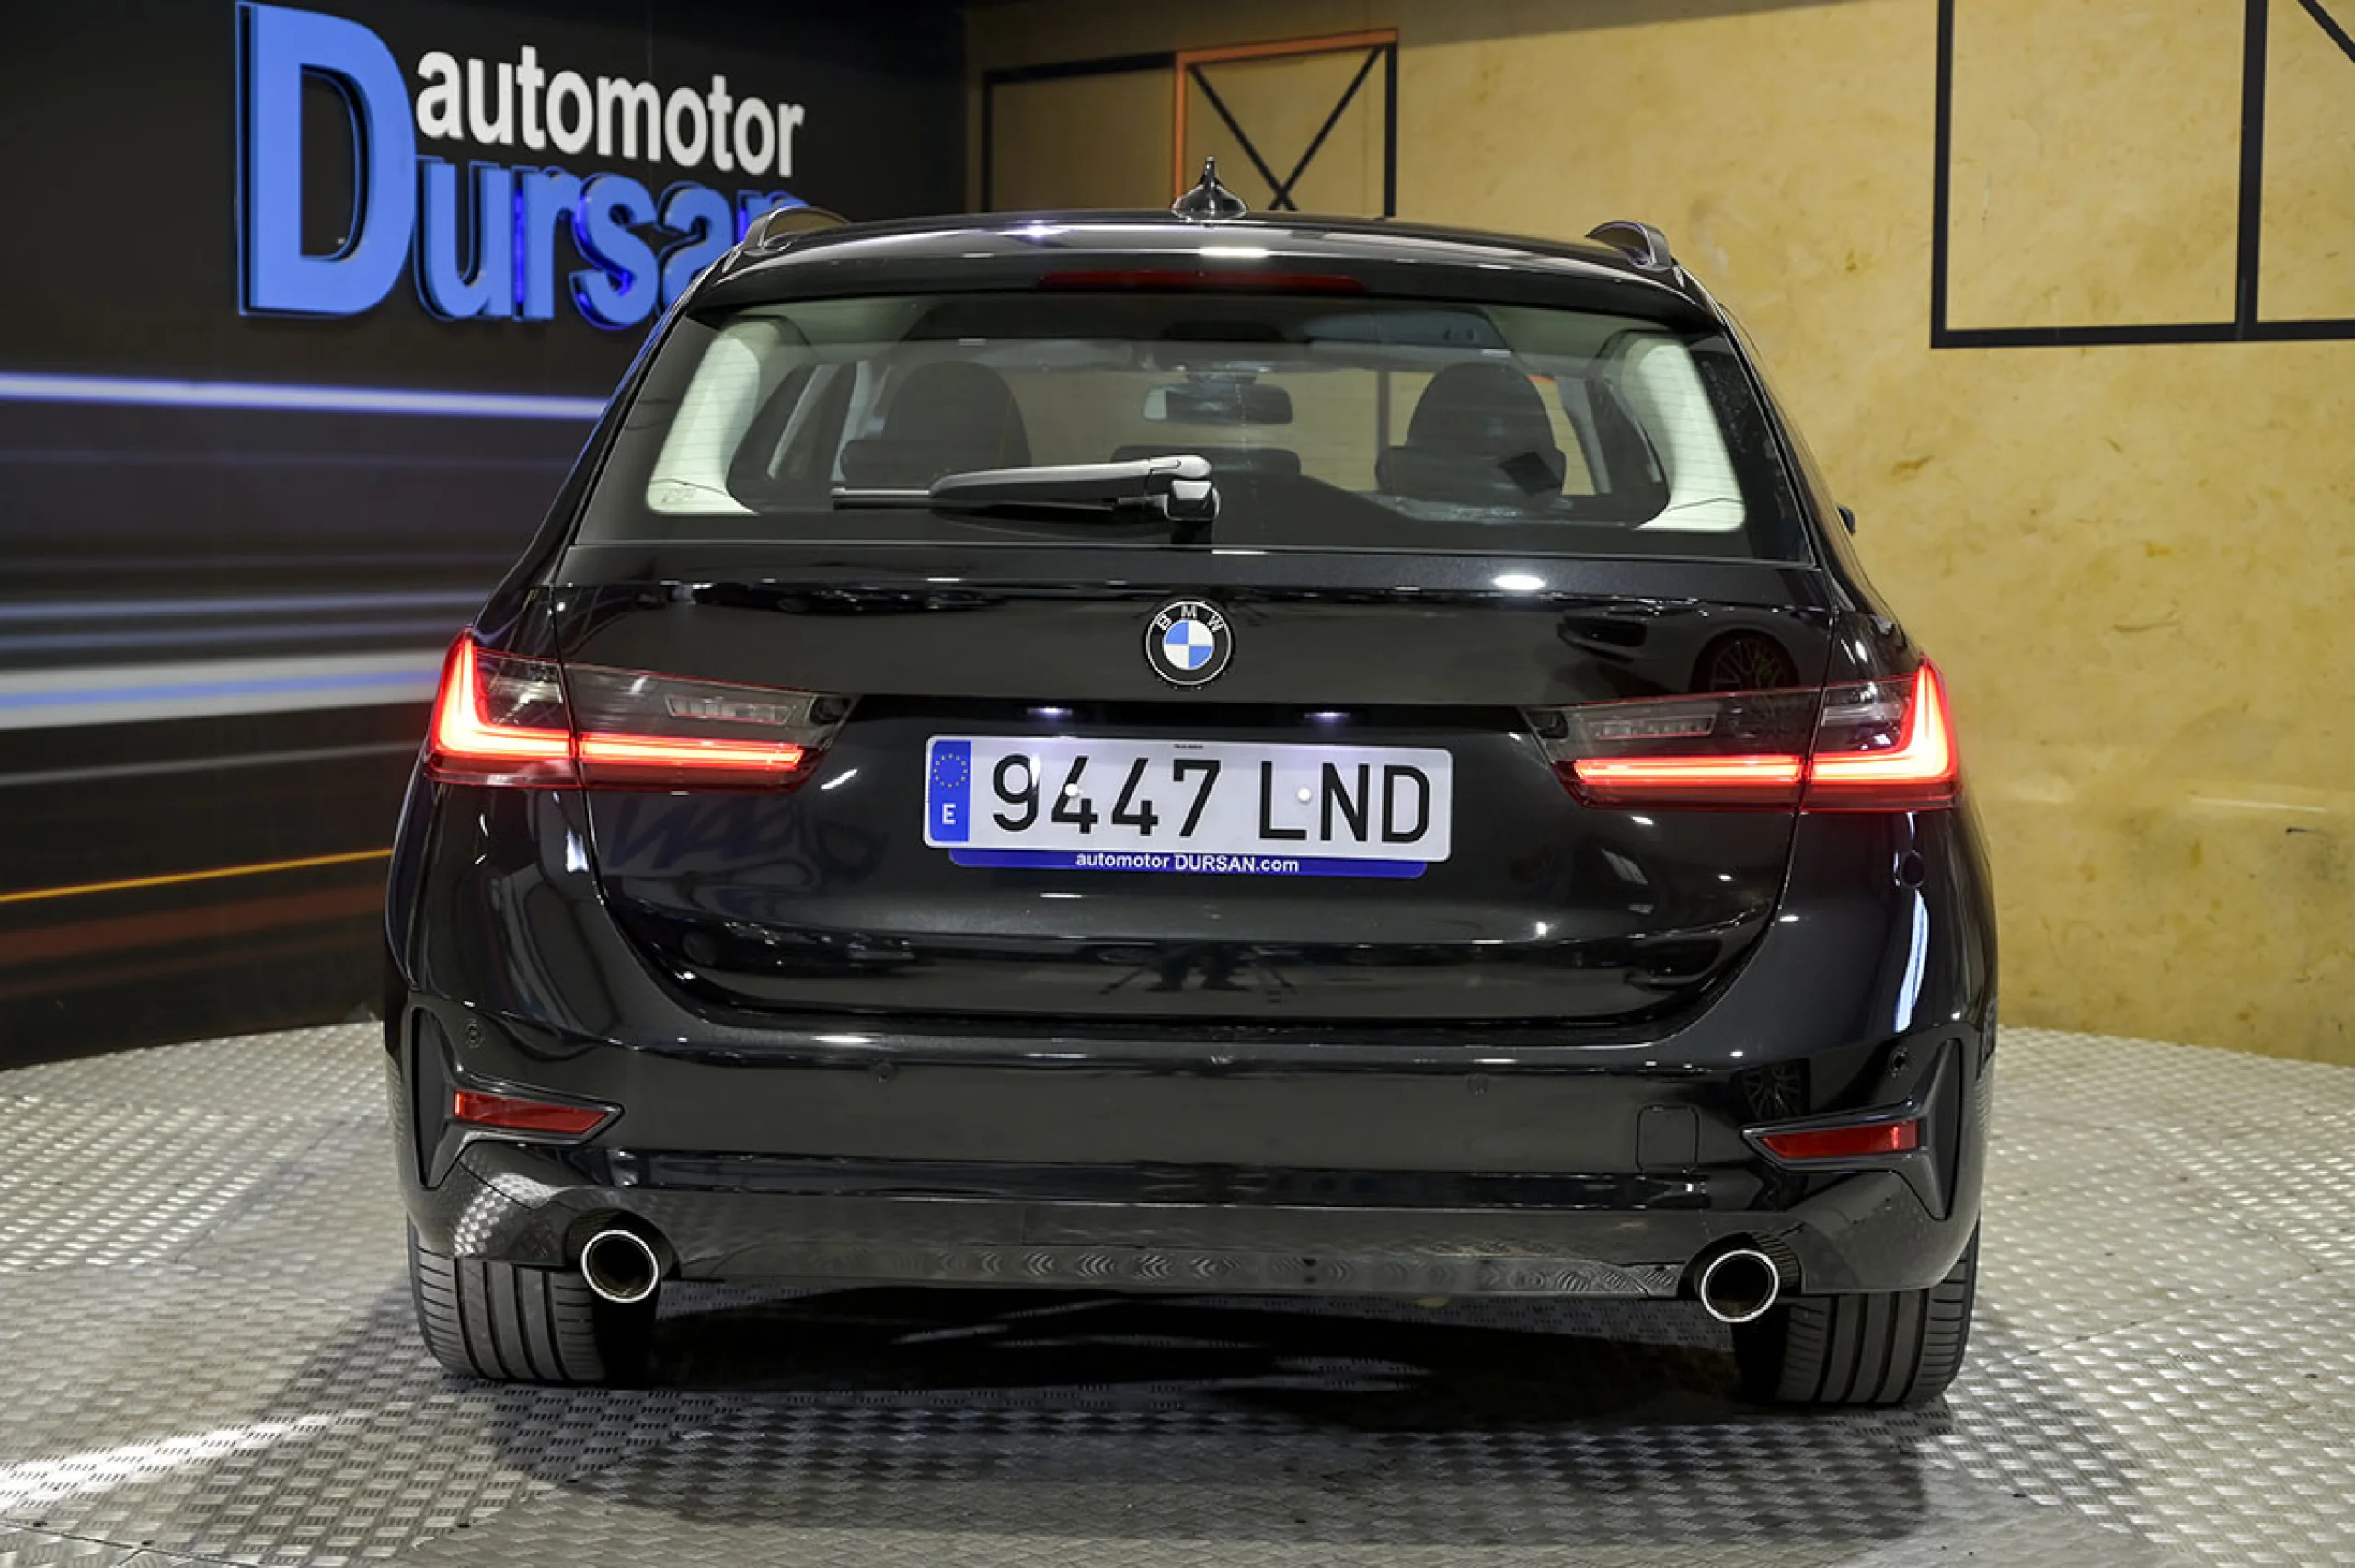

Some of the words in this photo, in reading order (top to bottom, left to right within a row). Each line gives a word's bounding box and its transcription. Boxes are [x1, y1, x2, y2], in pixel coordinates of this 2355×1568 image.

[416, 45, 805, 177] automotor
[1154, 603, 1224, 633] BMW
[992, 753, 1222, 837] 9447
[1258, 761, 1430, 843] LND
[941, 802, 957, 825] E
[1074, 853, 1170, 868] automotor
[1173, 853, 1300, 873] DURSAN.com
